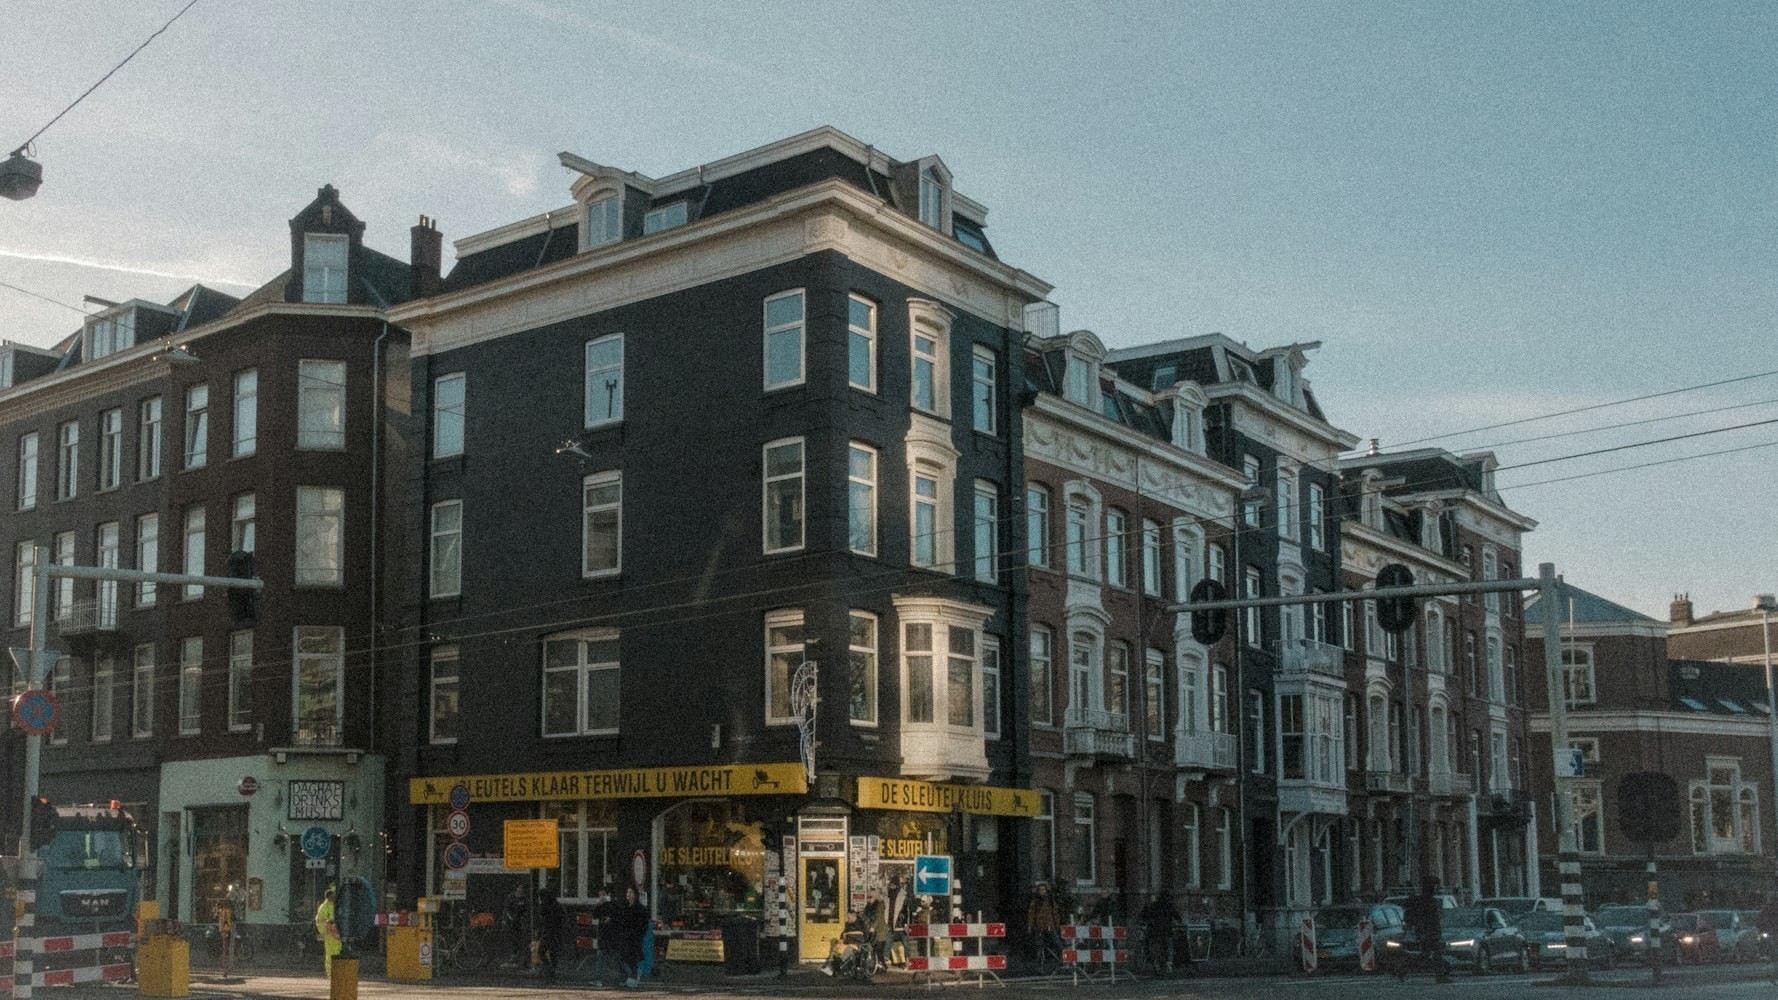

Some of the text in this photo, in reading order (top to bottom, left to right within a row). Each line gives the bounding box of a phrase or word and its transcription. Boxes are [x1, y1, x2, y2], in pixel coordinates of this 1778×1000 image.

[458, 769, 733, 798] LEUTELS KLAAR TERWIJL U WACHT
[882, 782, 898, 803] DE
[292, 794, 340, 807] DRINKS
[295, 806, 339, 819] MUSIC
[452, 819, 467, 830] 30
[660, 847, 676, 865] DE
